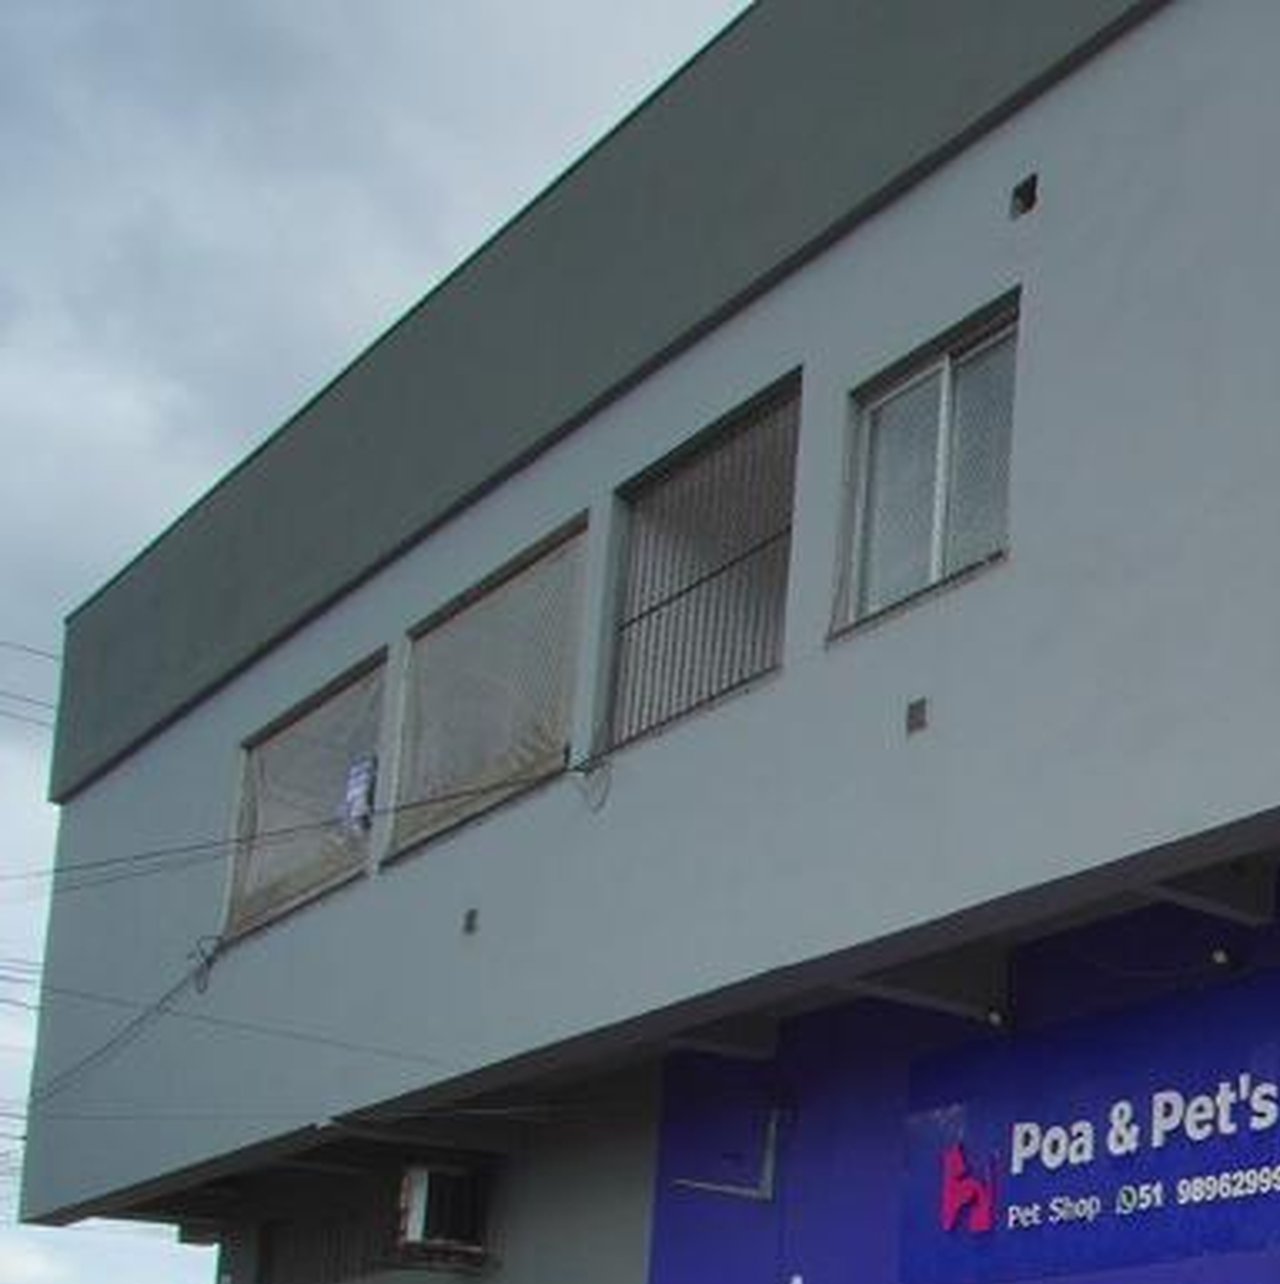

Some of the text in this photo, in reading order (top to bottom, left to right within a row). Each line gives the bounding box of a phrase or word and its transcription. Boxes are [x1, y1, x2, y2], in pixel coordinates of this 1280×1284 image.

[1010, 1073, 1279, 1175] Poa & Pet's
[1007, 1203, 1043, 1229] Pet
[1048, 1195, 1101, 1224] Shop
